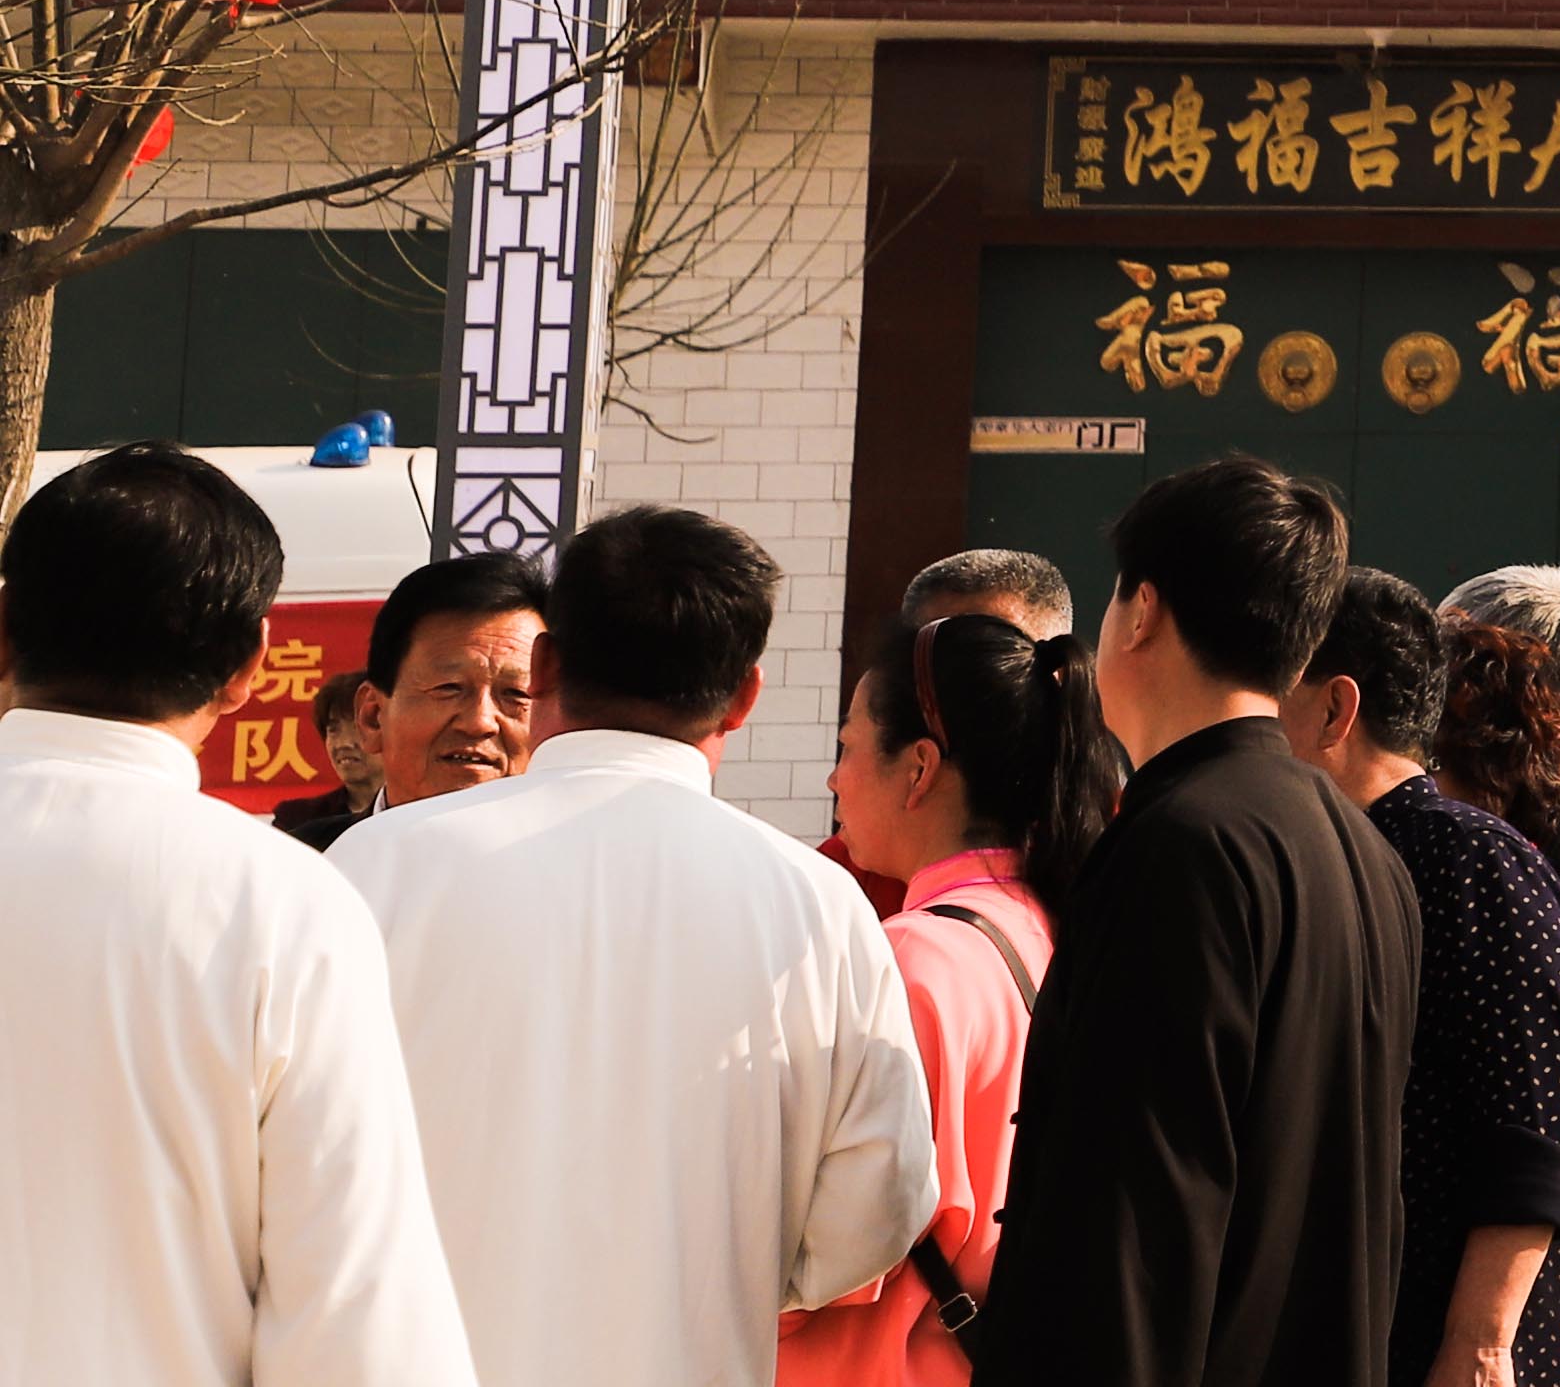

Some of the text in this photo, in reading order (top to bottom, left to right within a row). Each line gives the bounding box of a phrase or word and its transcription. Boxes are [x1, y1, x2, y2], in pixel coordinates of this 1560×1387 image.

[1095, 259, 1244, 397] 福
[1075, 421, 1137, 449] 门厂
[250, 639, 323, 704] 院
[232, 717, 318, 783] 队
